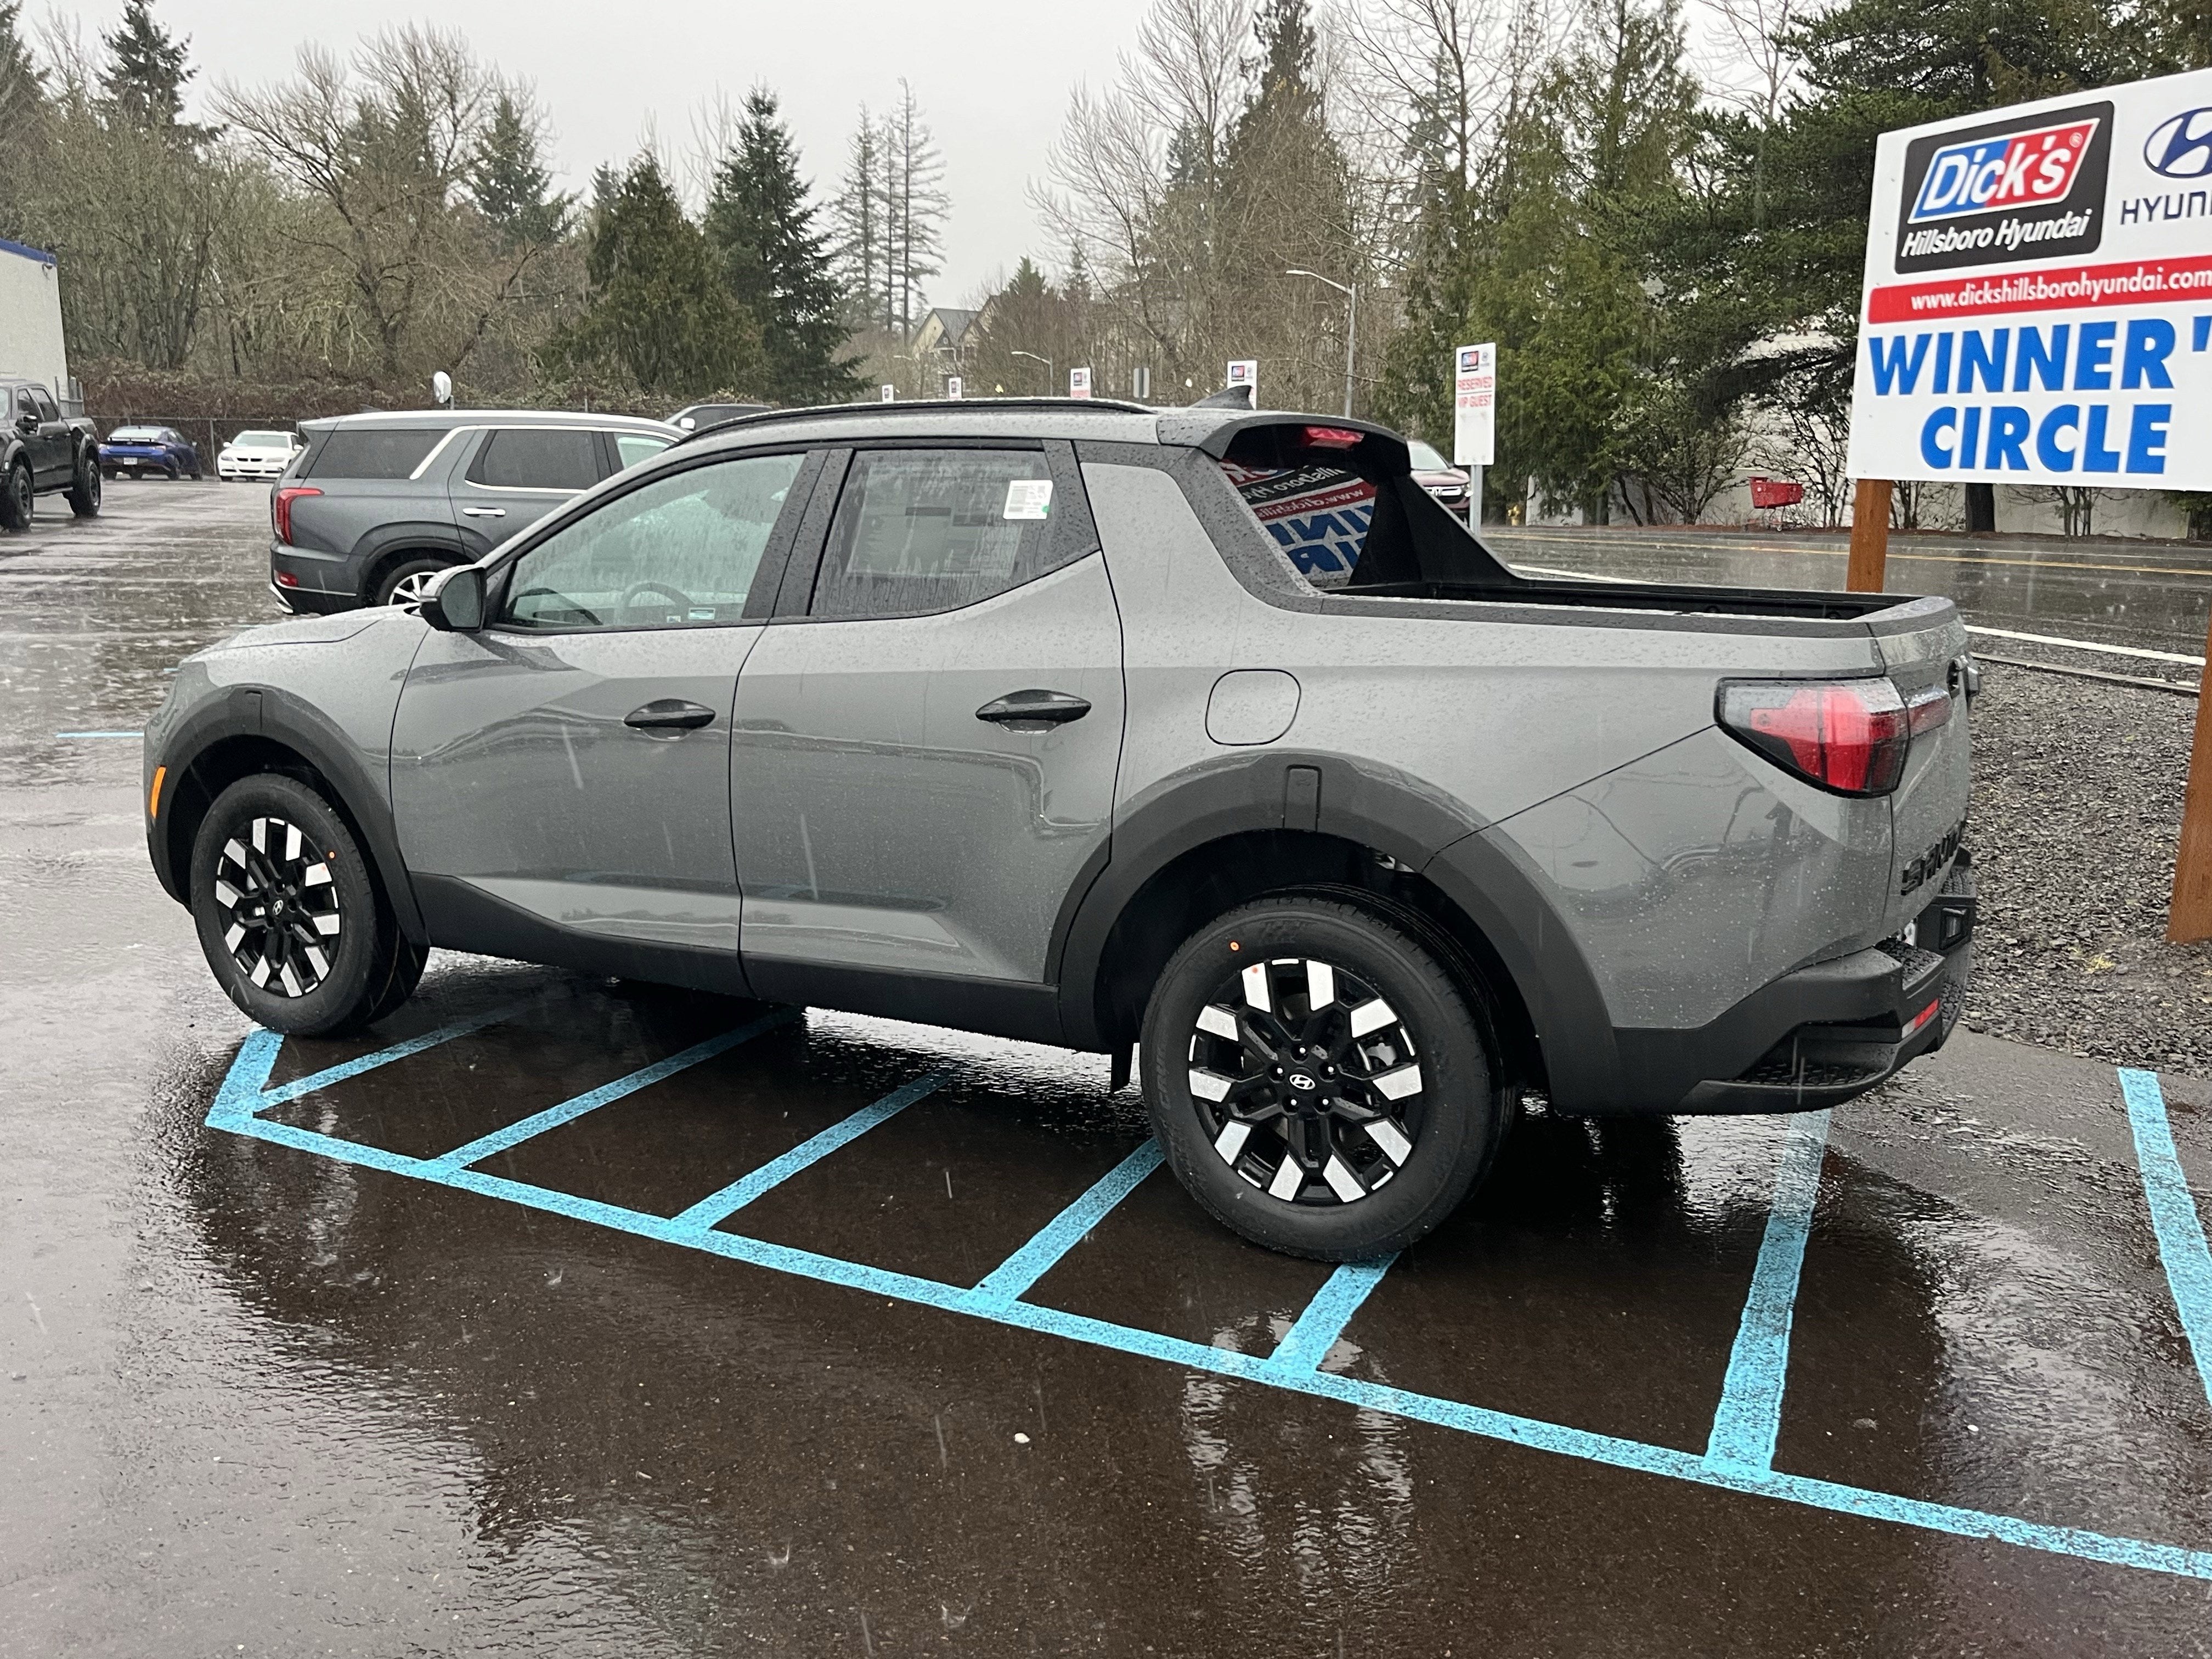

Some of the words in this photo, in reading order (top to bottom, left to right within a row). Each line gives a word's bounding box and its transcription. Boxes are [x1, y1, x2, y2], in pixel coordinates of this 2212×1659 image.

[1922, 135, 2072, 211] Dick's
[1901, 226, 1994, 257] Hillsboro
[1994, 208, 2093, 251] Hyundai
[2120, 191, 2212, 225] HYUN
[1911, 267, 2212, 310] www.dickshillsborohyundai.com
[1921, 404, 2172, 475] CIRCLE
